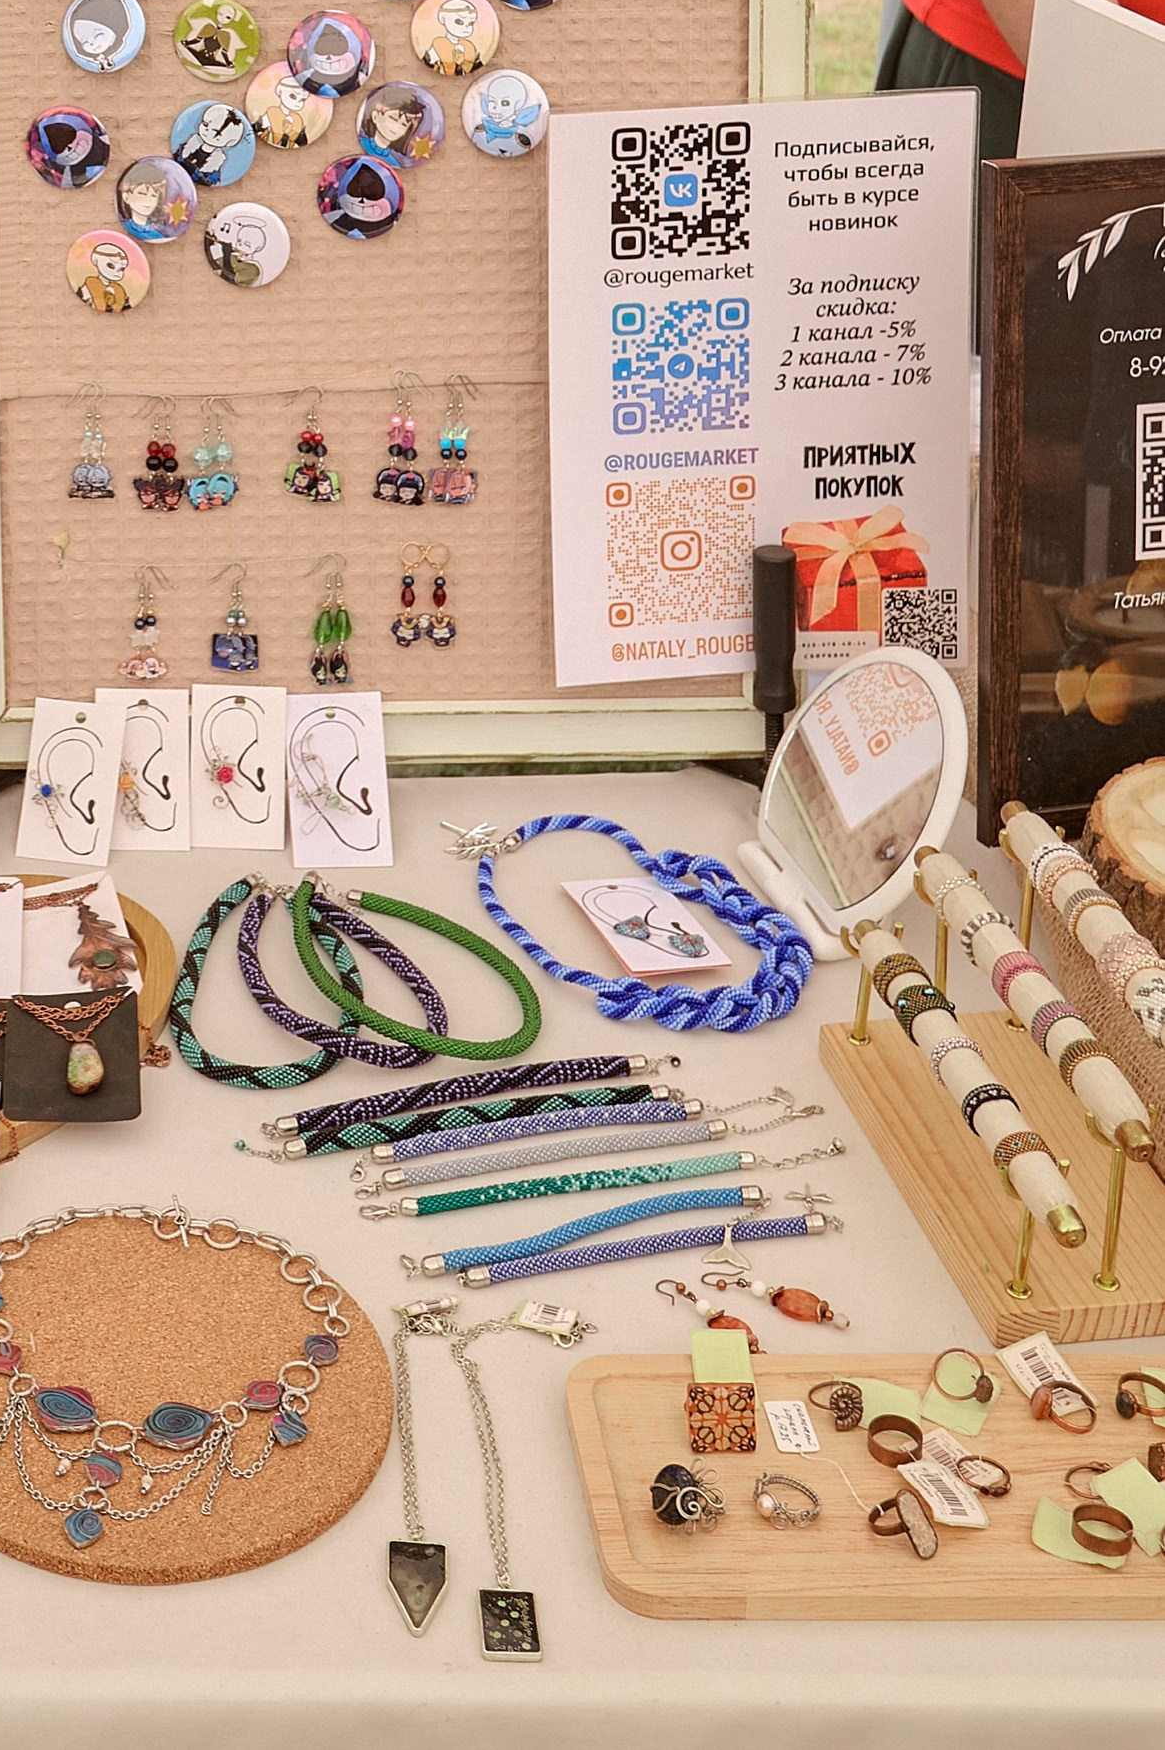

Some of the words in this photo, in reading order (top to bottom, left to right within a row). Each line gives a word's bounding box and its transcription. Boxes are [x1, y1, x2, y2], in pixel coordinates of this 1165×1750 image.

[774, 134, 935, 159] Подписывайся,
[784, 163, 848, 181] чтобы
[855, 162, 924, 179] всегда
[788, 191, 838, 208] быть
[844, 192, 856, 204] в
[862, 188, 919, 207] курсе
[809, 215, 899, 232] новинок
[604, 262, 754, 288] @rougemarket
[787, 278, 813, 295] За
[820, 273, 920, 295] подписку
[816, 297, 897, 318] скидка:
[791, 325, 801, 343] 1
[808, 326, 873, 342] канал
[879, 319, 917, 339] -5%
[1099, 327, 1162, 344] Оплата
[780, 350, 793, 367] 2
[799, 349, 877, 366] канала
[897, 343, 926, 362] 7%
[774, 373, 787, 391] 3
[793, 373, 870, 390] канала
[891, 367, 932, 386] 10%
[604, 447, 759, 473] @ROUGEMARKET
[803, 442, 917, 469] ПРИЯТНЫХ
[815, 474, 905, 500] ПОКУПОК
[612, 634, 754, 662] @NATALY_ROUGE
